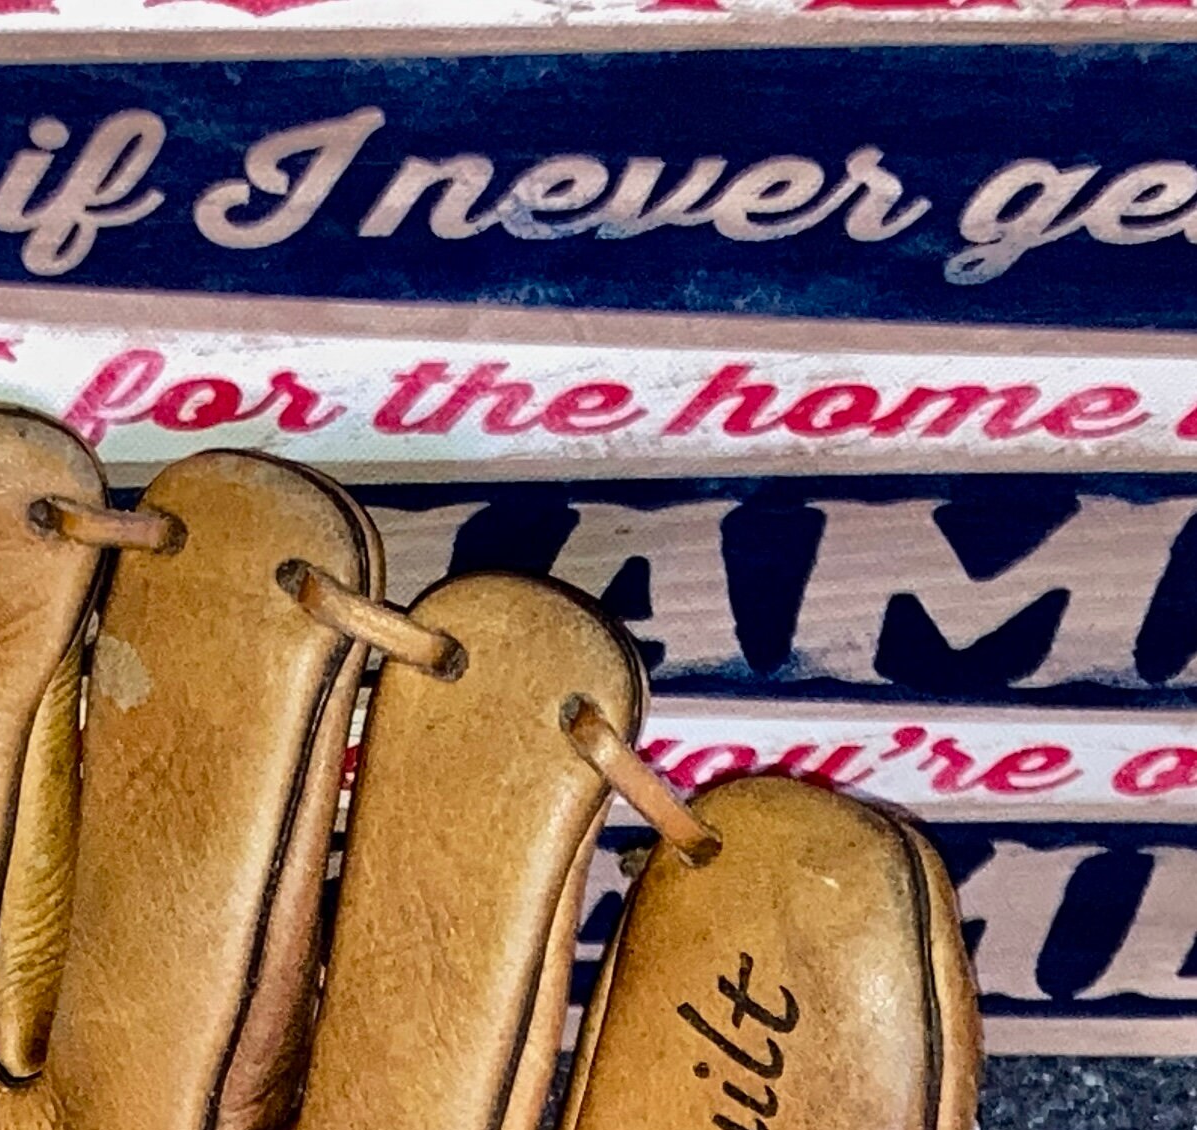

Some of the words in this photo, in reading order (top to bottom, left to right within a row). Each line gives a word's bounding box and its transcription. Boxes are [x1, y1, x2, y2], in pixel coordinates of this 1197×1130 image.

[358, 145, 931, 242] never
[944, 157, 1197, 286] ge
[67, 348, 346, 447] for
[373, 361, 649, 437] the
[660, 363, 1150, 440] home
